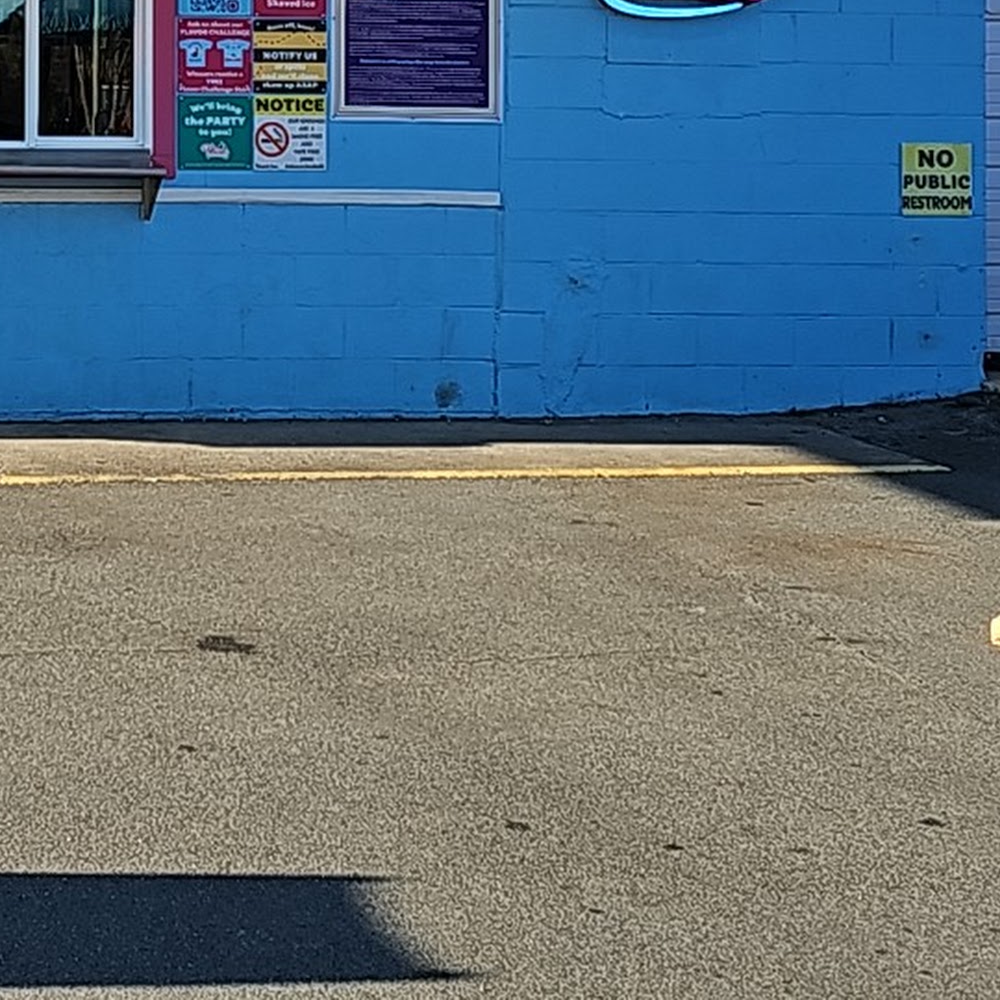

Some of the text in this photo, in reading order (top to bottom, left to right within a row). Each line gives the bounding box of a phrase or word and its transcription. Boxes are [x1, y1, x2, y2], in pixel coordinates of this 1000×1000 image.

[266, 0, 300, 8] Shaved
[262, 52, 318, 60] NOTIFY US
[189, 102, 242, 114] We'll bring
[256, 98, 325, 112] NOTICE
[184, 115, 246, 126] the PARTY
[198, 128, 232, 138] to you!
[918, 149, 954, 168] NO
[904, 174, 970, 190] PUBLIC
[901, 196, 972, 210] RESTROOM
